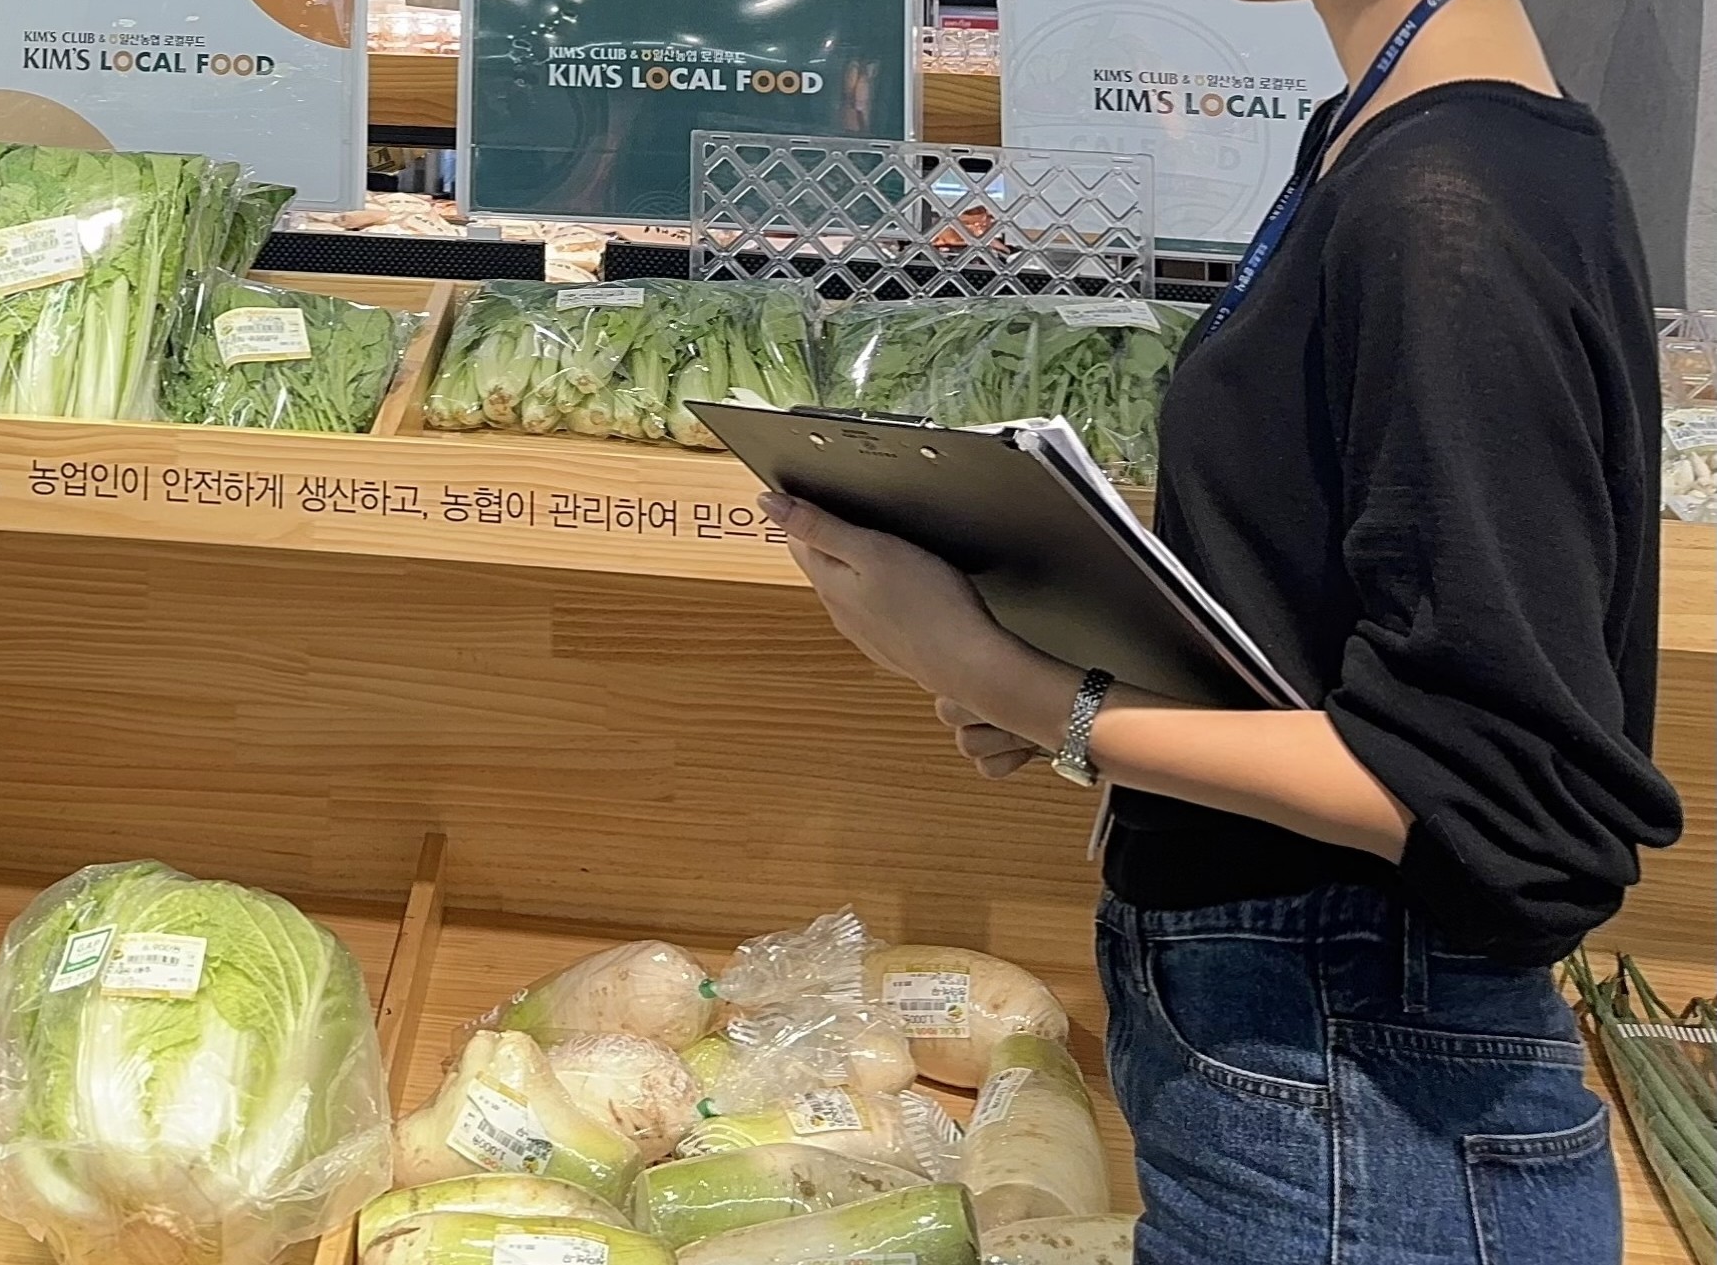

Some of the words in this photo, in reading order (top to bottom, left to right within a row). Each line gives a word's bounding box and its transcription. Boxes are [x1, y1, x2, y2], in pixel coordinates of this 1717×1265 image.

[23, 31, 57, 43] KIM'S
[62, 32, 95, 44] CLUB
[119, 33, 161, 46] 일산농협
[164, 35, 206, 47] 로컬푸드
[23, 47, 90, 70] KIM'S
[100, 50, 186, 73] LOCAL
[197, 53, 275, 76] FOOD
[548, 46, 585, 60] KIM'S
[590, 47, 627, 61] CLUB
[700, 50, 747, 64] 로컬푸드
[548, 63, 623, 88] KIM'S
[632, 66, 727, 91] LOCAL
[736, 69, 824, 94] FOOD
[1093, 69, 1132, 82] KIM'S
[1138, 71, 1178, 85] CLUB
[1206, 74, 1255, 89] 일산농협
[1259, 76, 1308, 91] 로컬푸드
[1094, 87, 1174, 115] KIM'S
[1185, 92, 1286, 120] LOCAL
[28, 459, 149, 501] 농업인이
[162, 468, 284, 509] 안전하게
[297, 475, 428, 520] 생산하고,
[440, 485, 534, 526] 농협이
[548, 493, 677, 536] 관리하여
